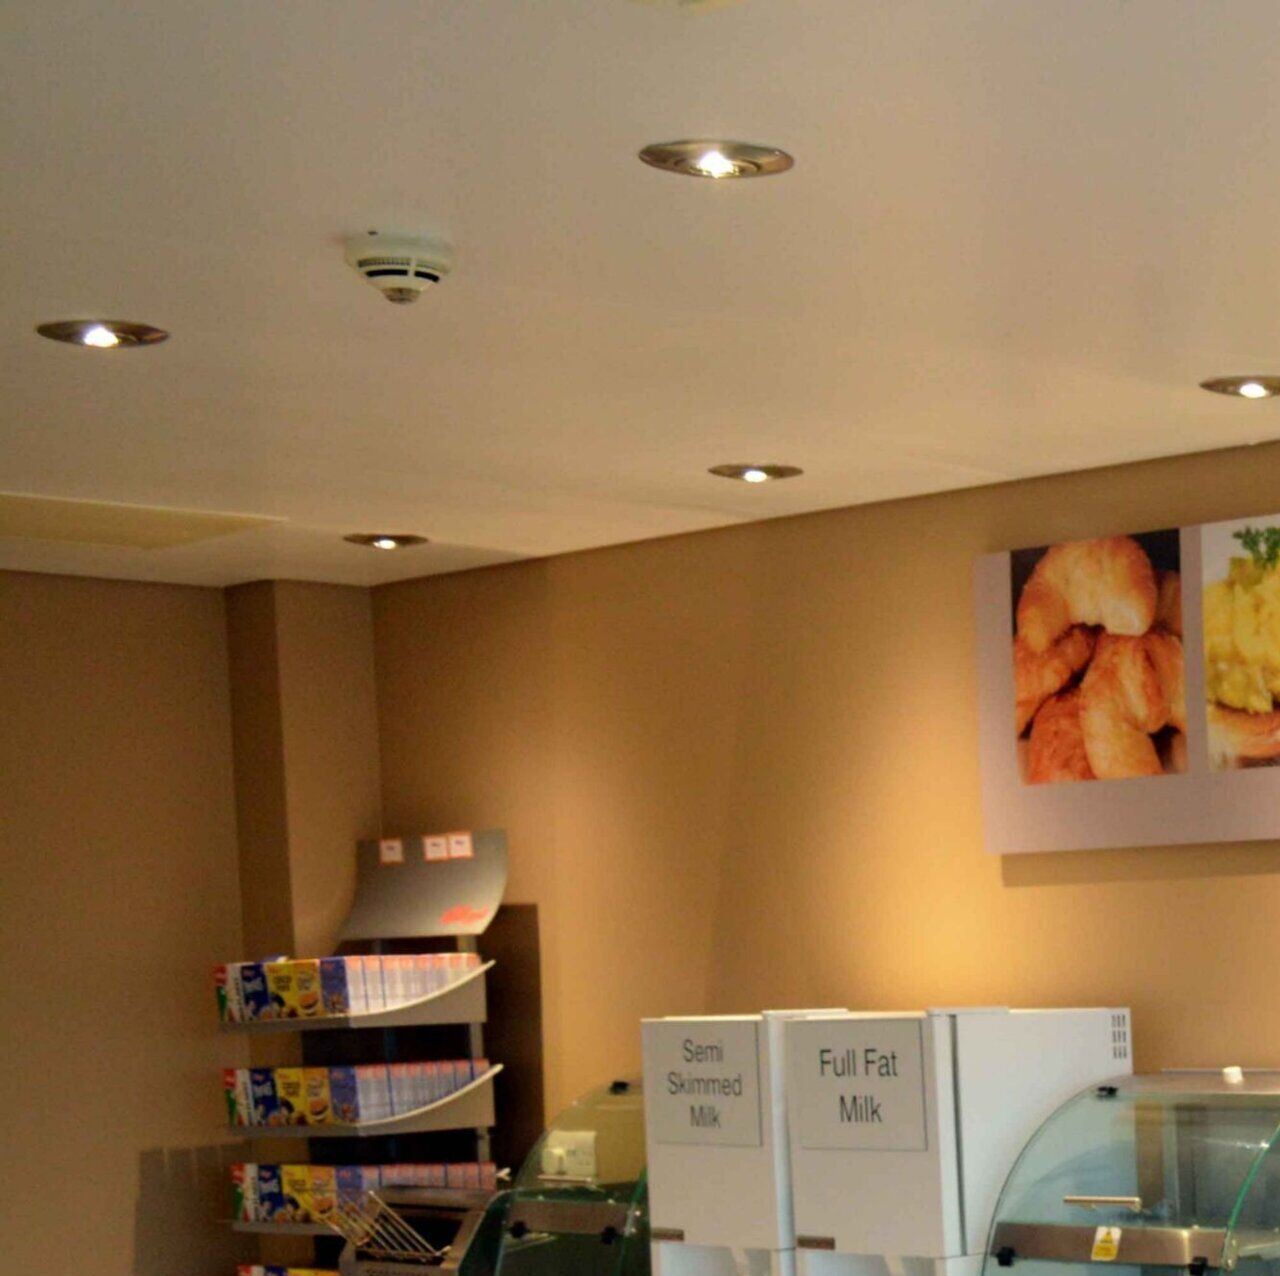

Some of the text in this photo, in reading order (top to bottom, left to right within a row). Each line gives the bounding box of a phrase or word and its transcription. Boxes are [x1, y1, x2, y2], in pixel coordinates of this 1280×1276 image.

[682, 1038, 724, 1063] Semi
[819, 1048, 899, 1077] Full Fat
[667, 1071, 743, 1098] Skimmed
[690, 1104, 722, 1129] Milk
[838, 1095, 884, 1123] Milk
